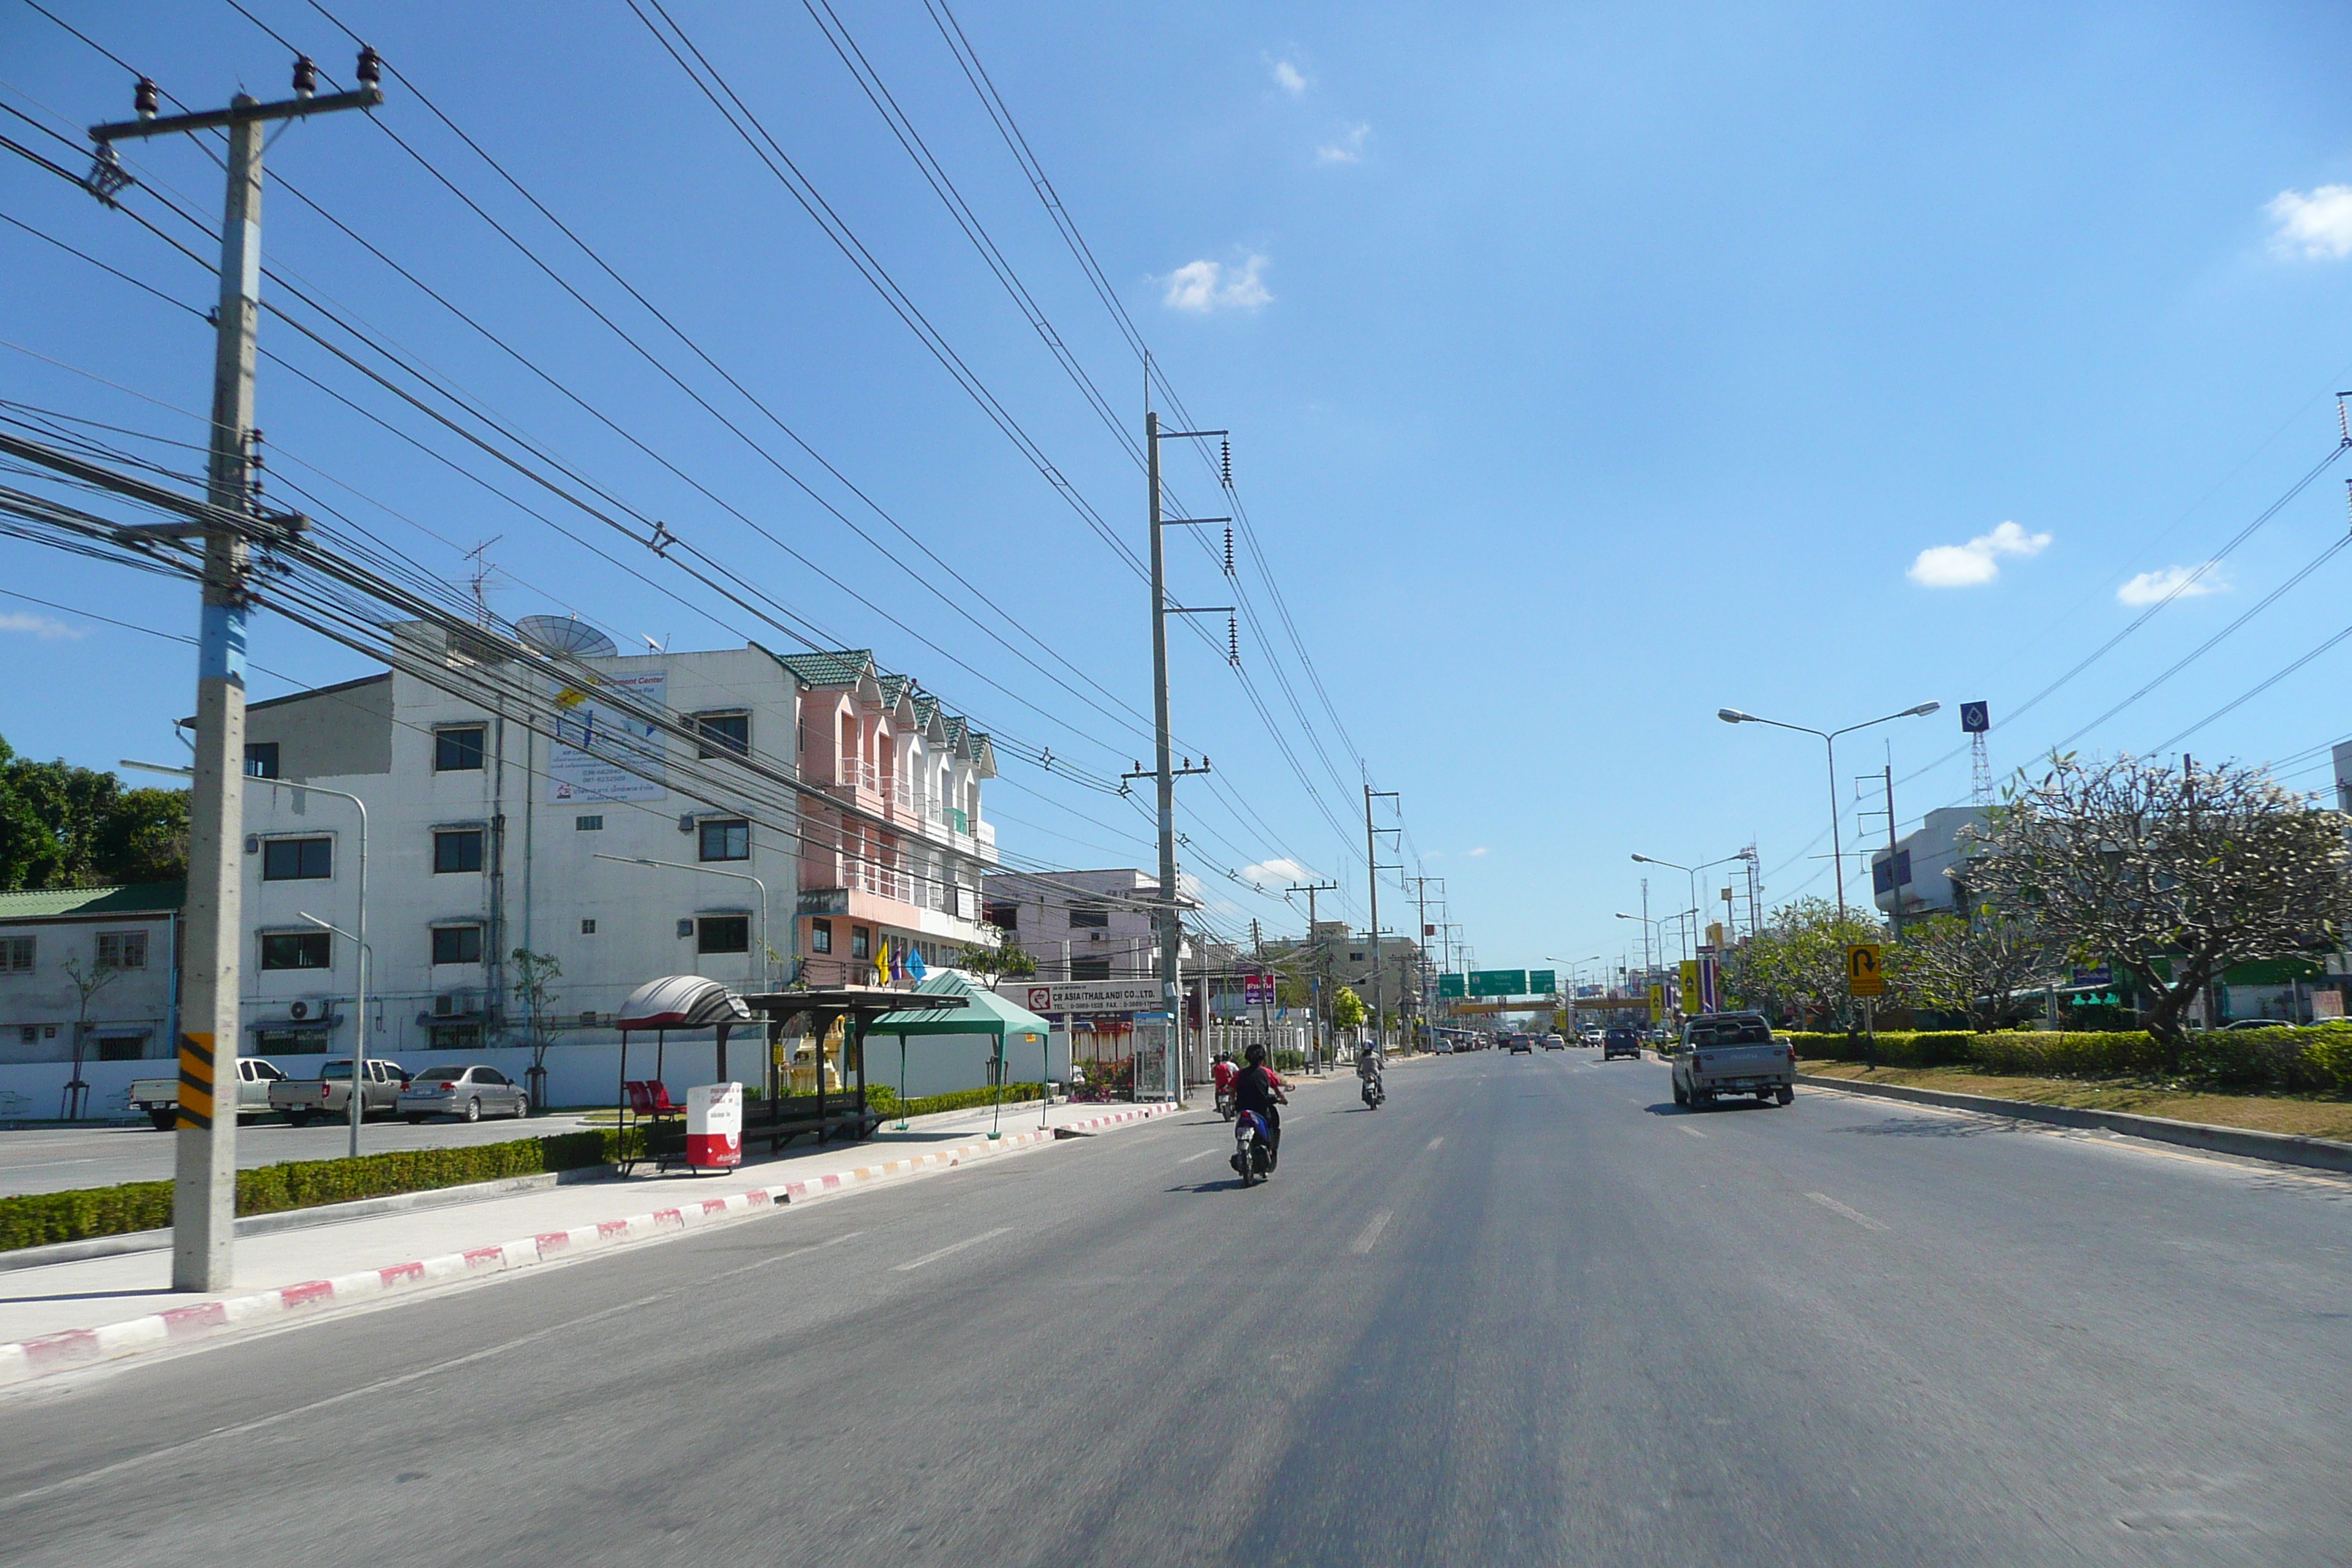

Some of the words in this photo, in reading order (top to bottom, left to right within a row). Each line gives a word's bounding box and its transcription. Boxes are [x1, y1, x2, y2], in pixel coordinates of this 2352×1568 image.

[638, 676, 664, 685] Center
[1053, 993, 1063, 1001] CR
[1064, 992, 1081, 1001] ASIA
